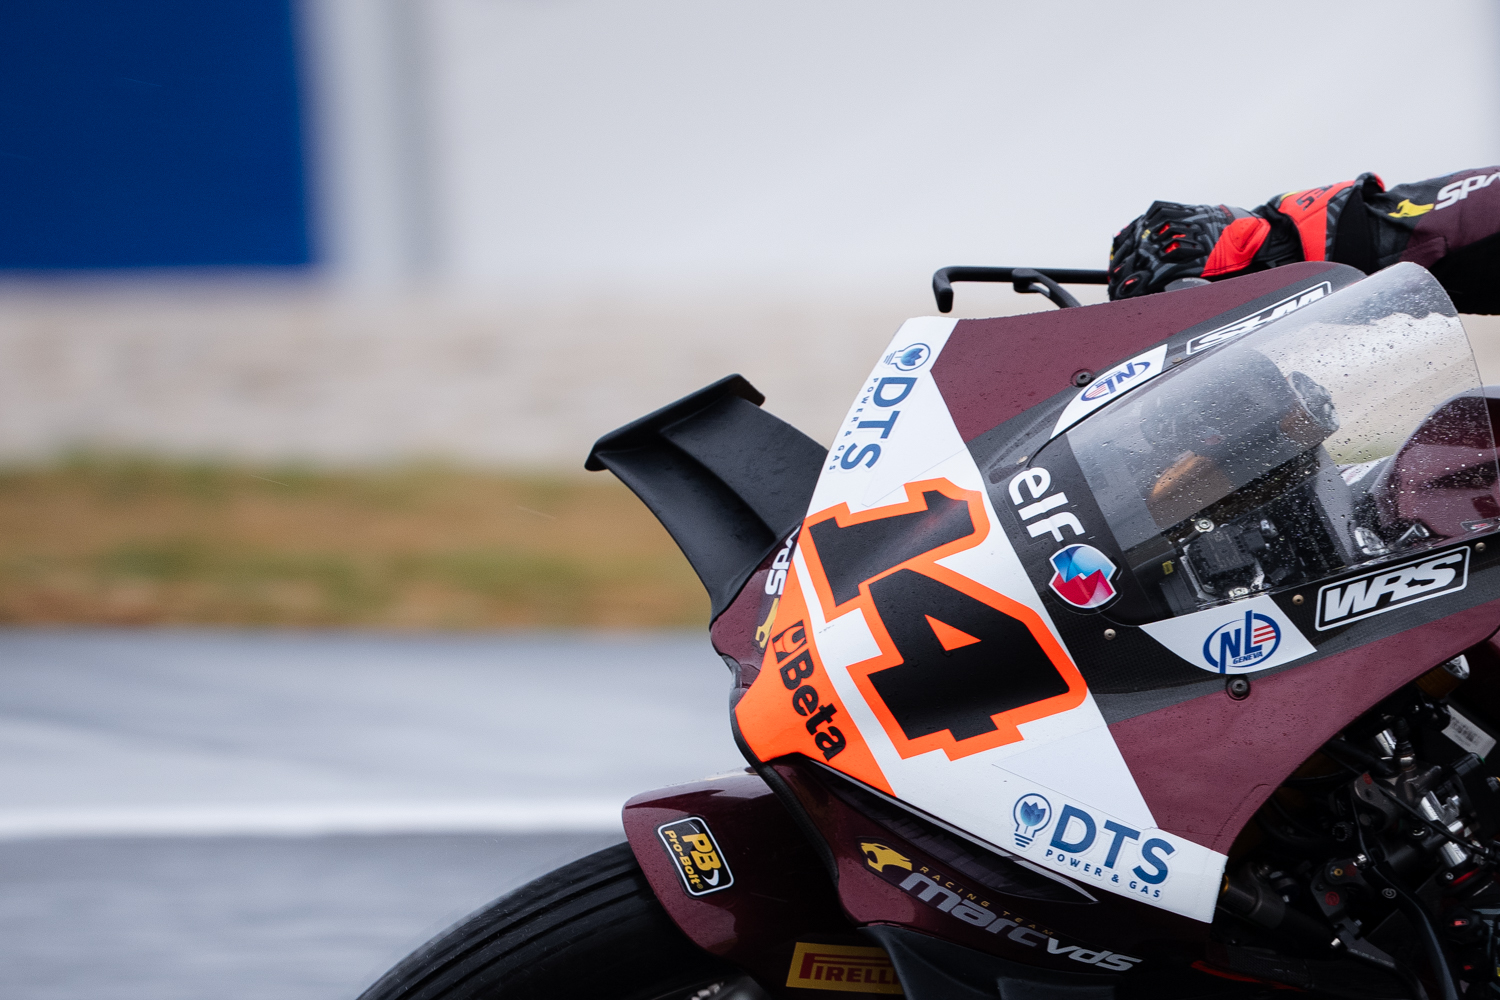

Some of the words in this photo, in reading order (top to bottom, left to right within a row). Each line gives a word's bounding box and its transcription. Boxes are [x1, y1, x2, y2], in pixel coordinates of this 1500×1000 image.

[840, 376, 918, 470] DTS
[1008, 466, 1085, 545] elf
[803, 484, 1079, 750] 14
[1324, 552, 1464, 622] WRS
[1218, 609, 1264, 675] NL
[1232, 650, 1264, 666] GENEVA
[777, 648, 847, 762] Beta
[681, 832, 722, 872] PB
[1045, 849, 1103, 877] POWER
[1110, 873, 1120, 884] &
[1129, 880, 1161, 898] GAS
[1049, 803, 1176, 885] DTS
[918, 865, 991, 908] RACING
[1002, 910, 1054, 936] TEAM
[798, 952, 900, 986] PIRELLI
